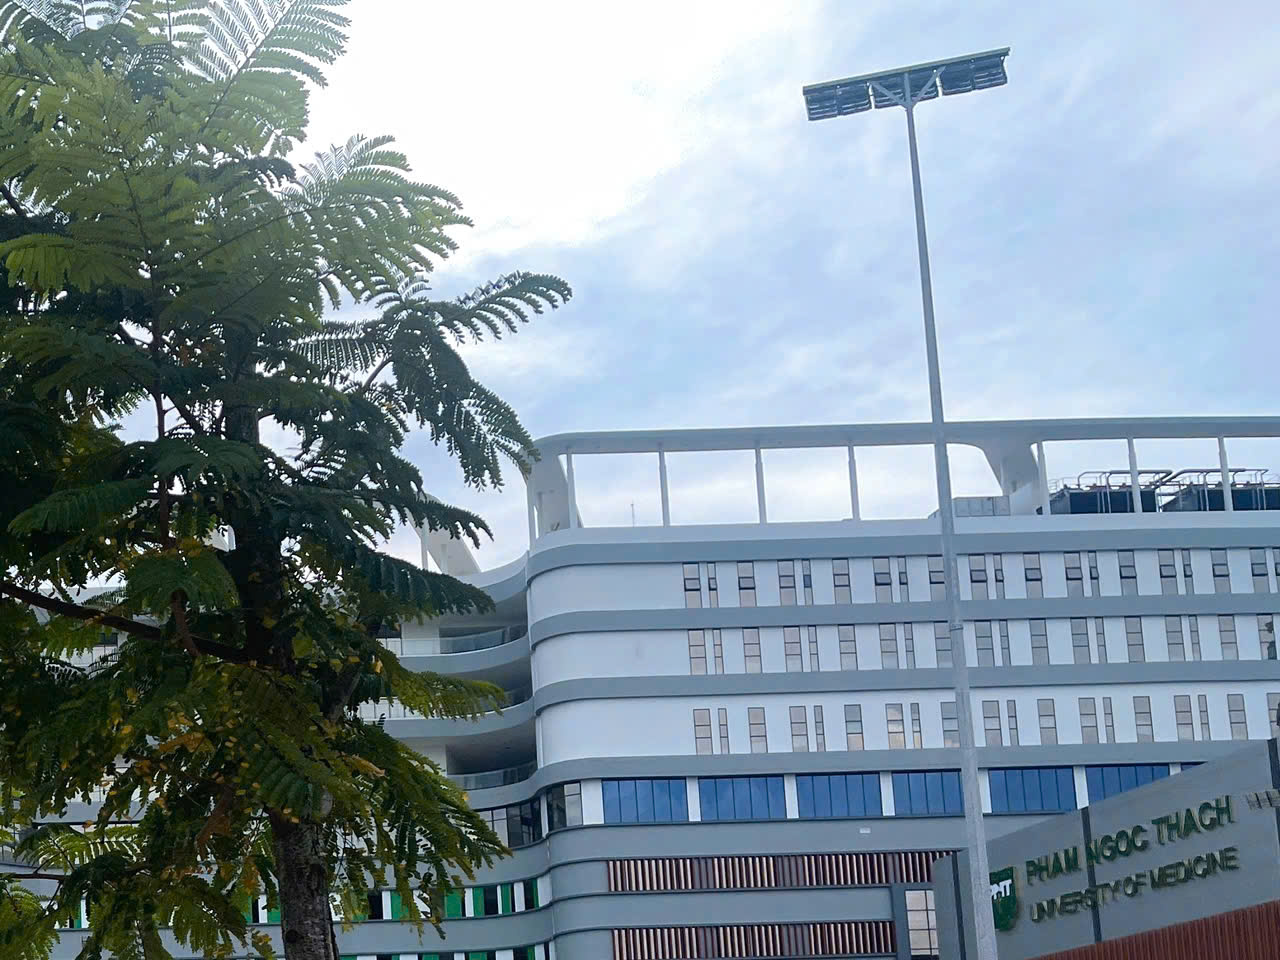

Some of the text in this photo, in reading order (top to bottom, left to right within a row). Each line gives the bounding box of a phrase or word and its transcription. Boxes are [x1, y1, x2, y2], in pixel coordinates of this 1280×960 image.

[1025, 794, 1236, 886] PHAM NGOC THACH
[1123, 872, 1147, 897] OF
[1149, 846, 1240, 890] MEDICINE
